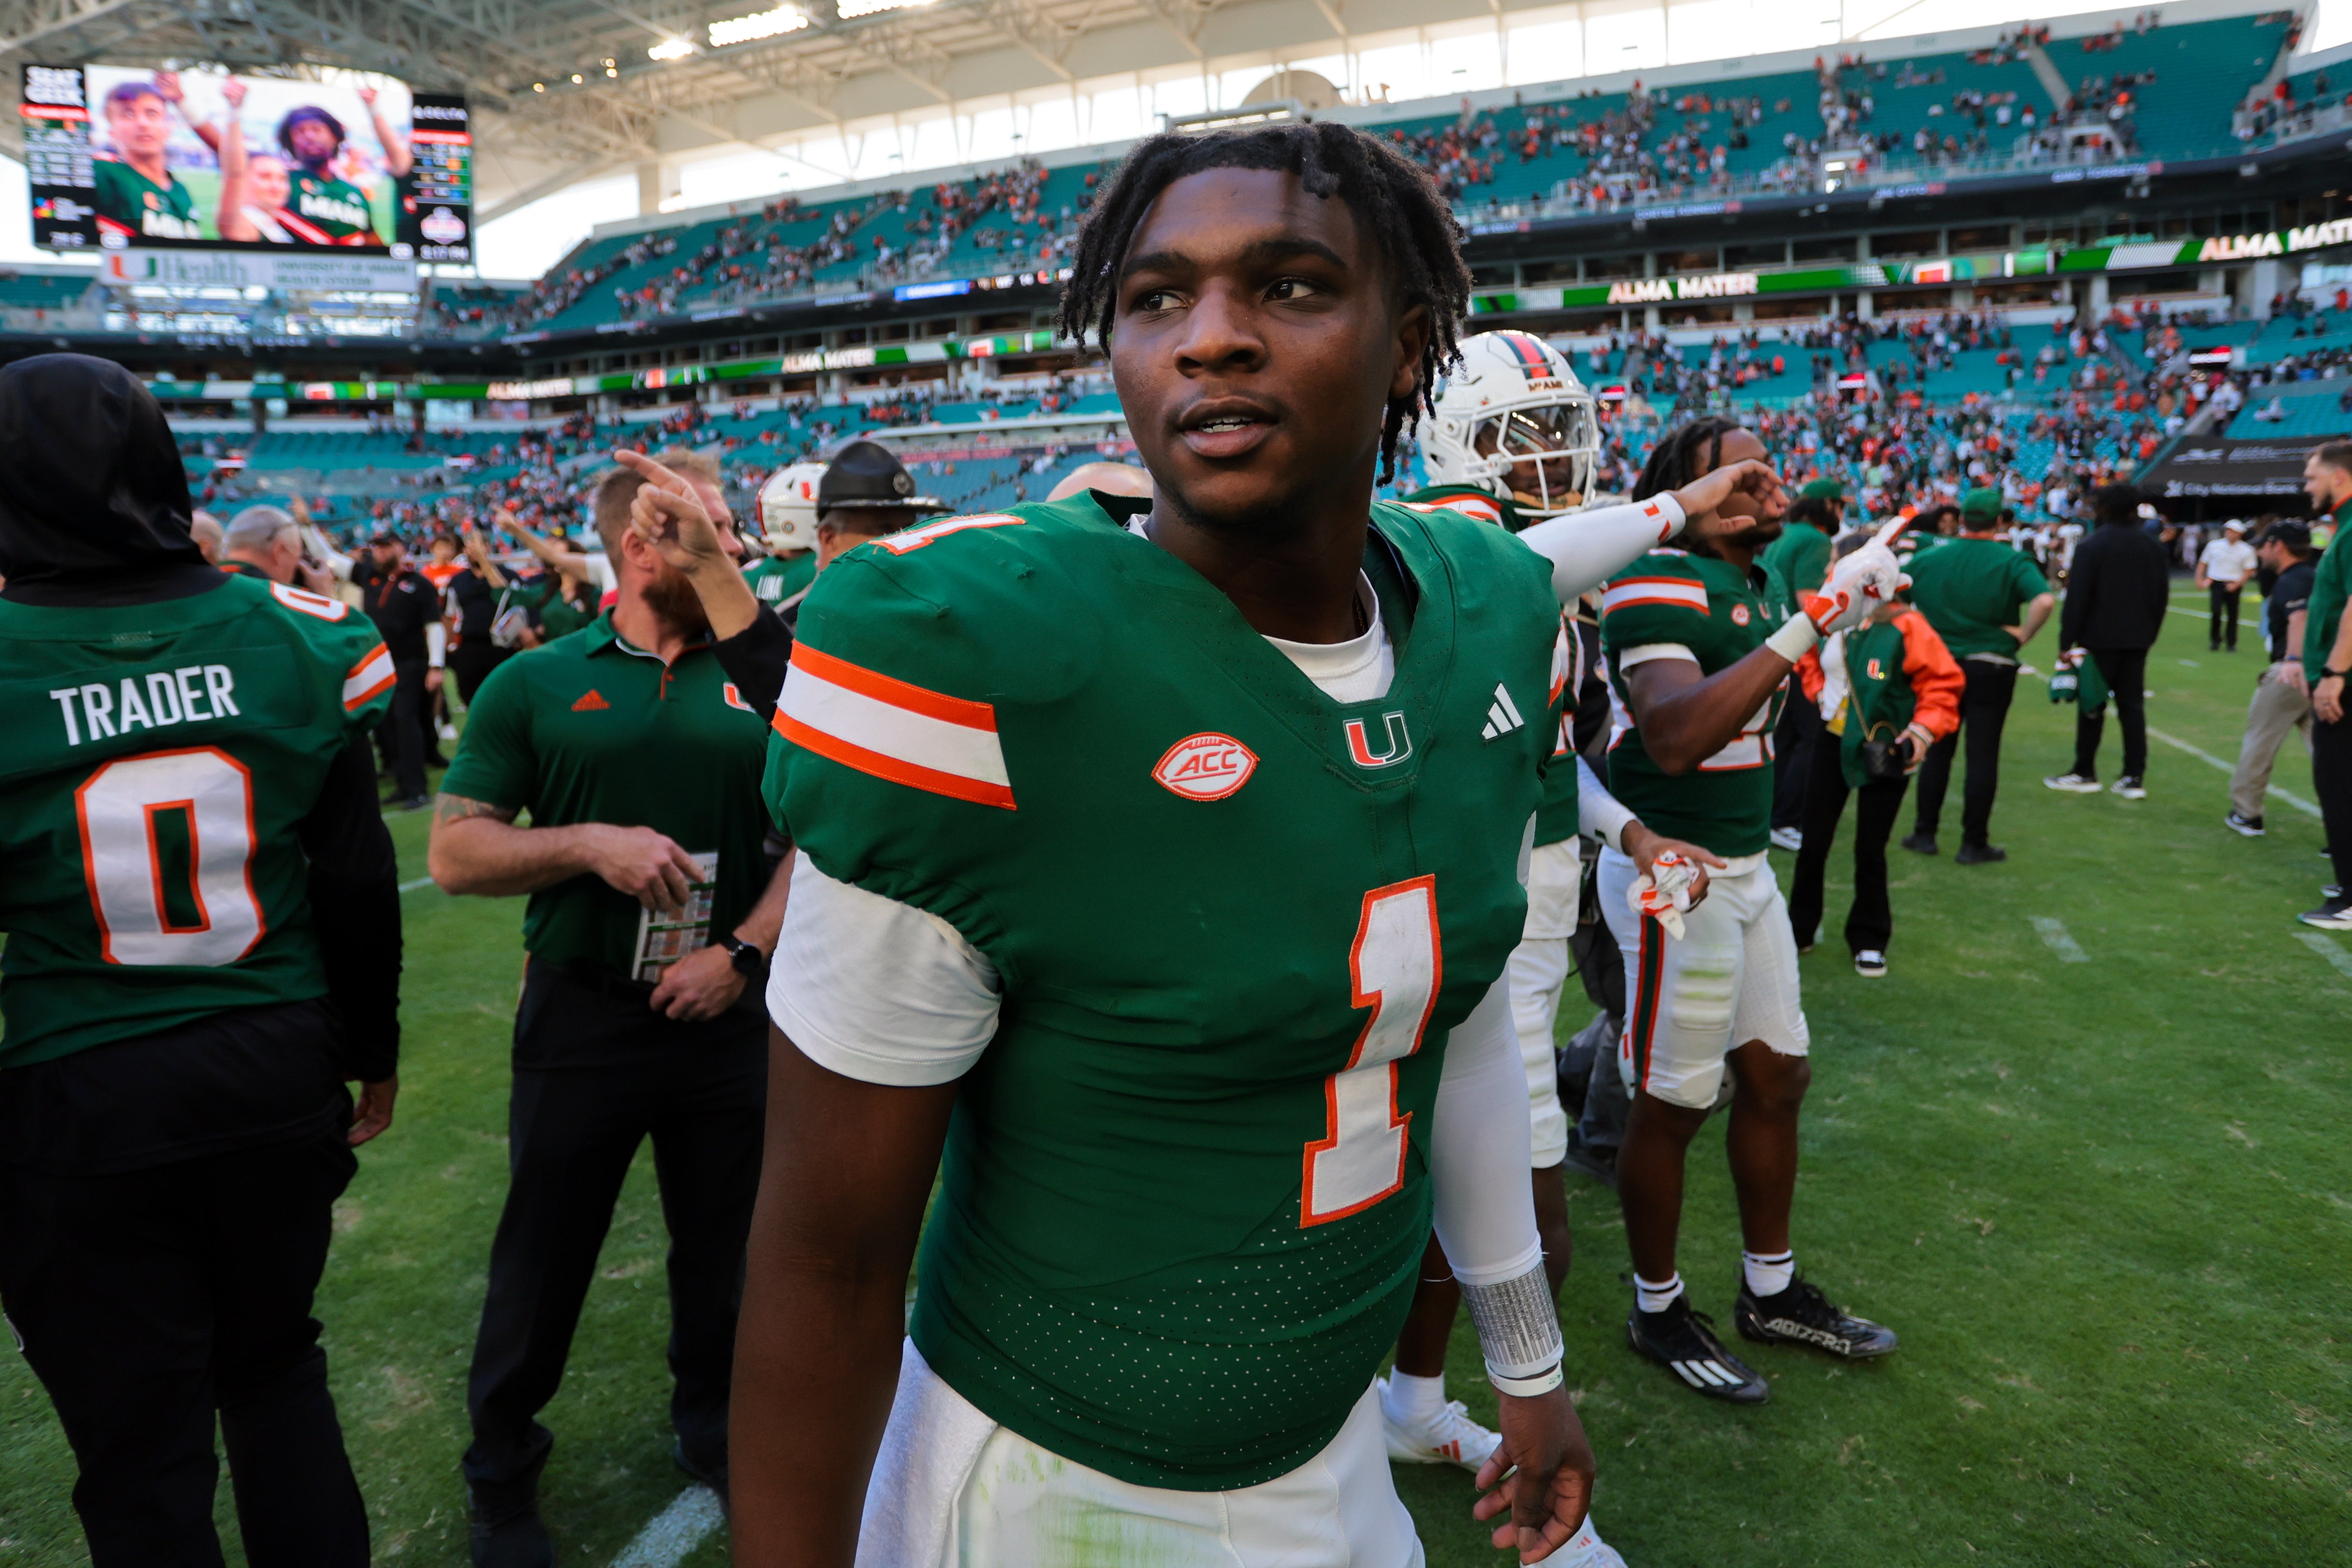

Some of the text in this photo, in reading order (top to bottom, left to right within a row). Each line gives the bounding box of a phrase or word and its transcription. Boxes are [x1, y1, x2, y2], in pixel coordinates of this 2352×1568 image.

[2197, 231, 2283, 261] ALMA
[163, 253, 248, 283] Health
[1607, 273, 1758, 304] ALMA MATER
[781, 348, 876, 374] ALMA MATER
[486, 377, 573, 400] ALMA MATER
[50, 664, 240, 746] TRADER
[1343, 711, 1413, 769] U
[1174, 749, 1238, 776] ACC
[75, 745, 267, 966] 0
[1300, 874, 1442, 1228] 1
